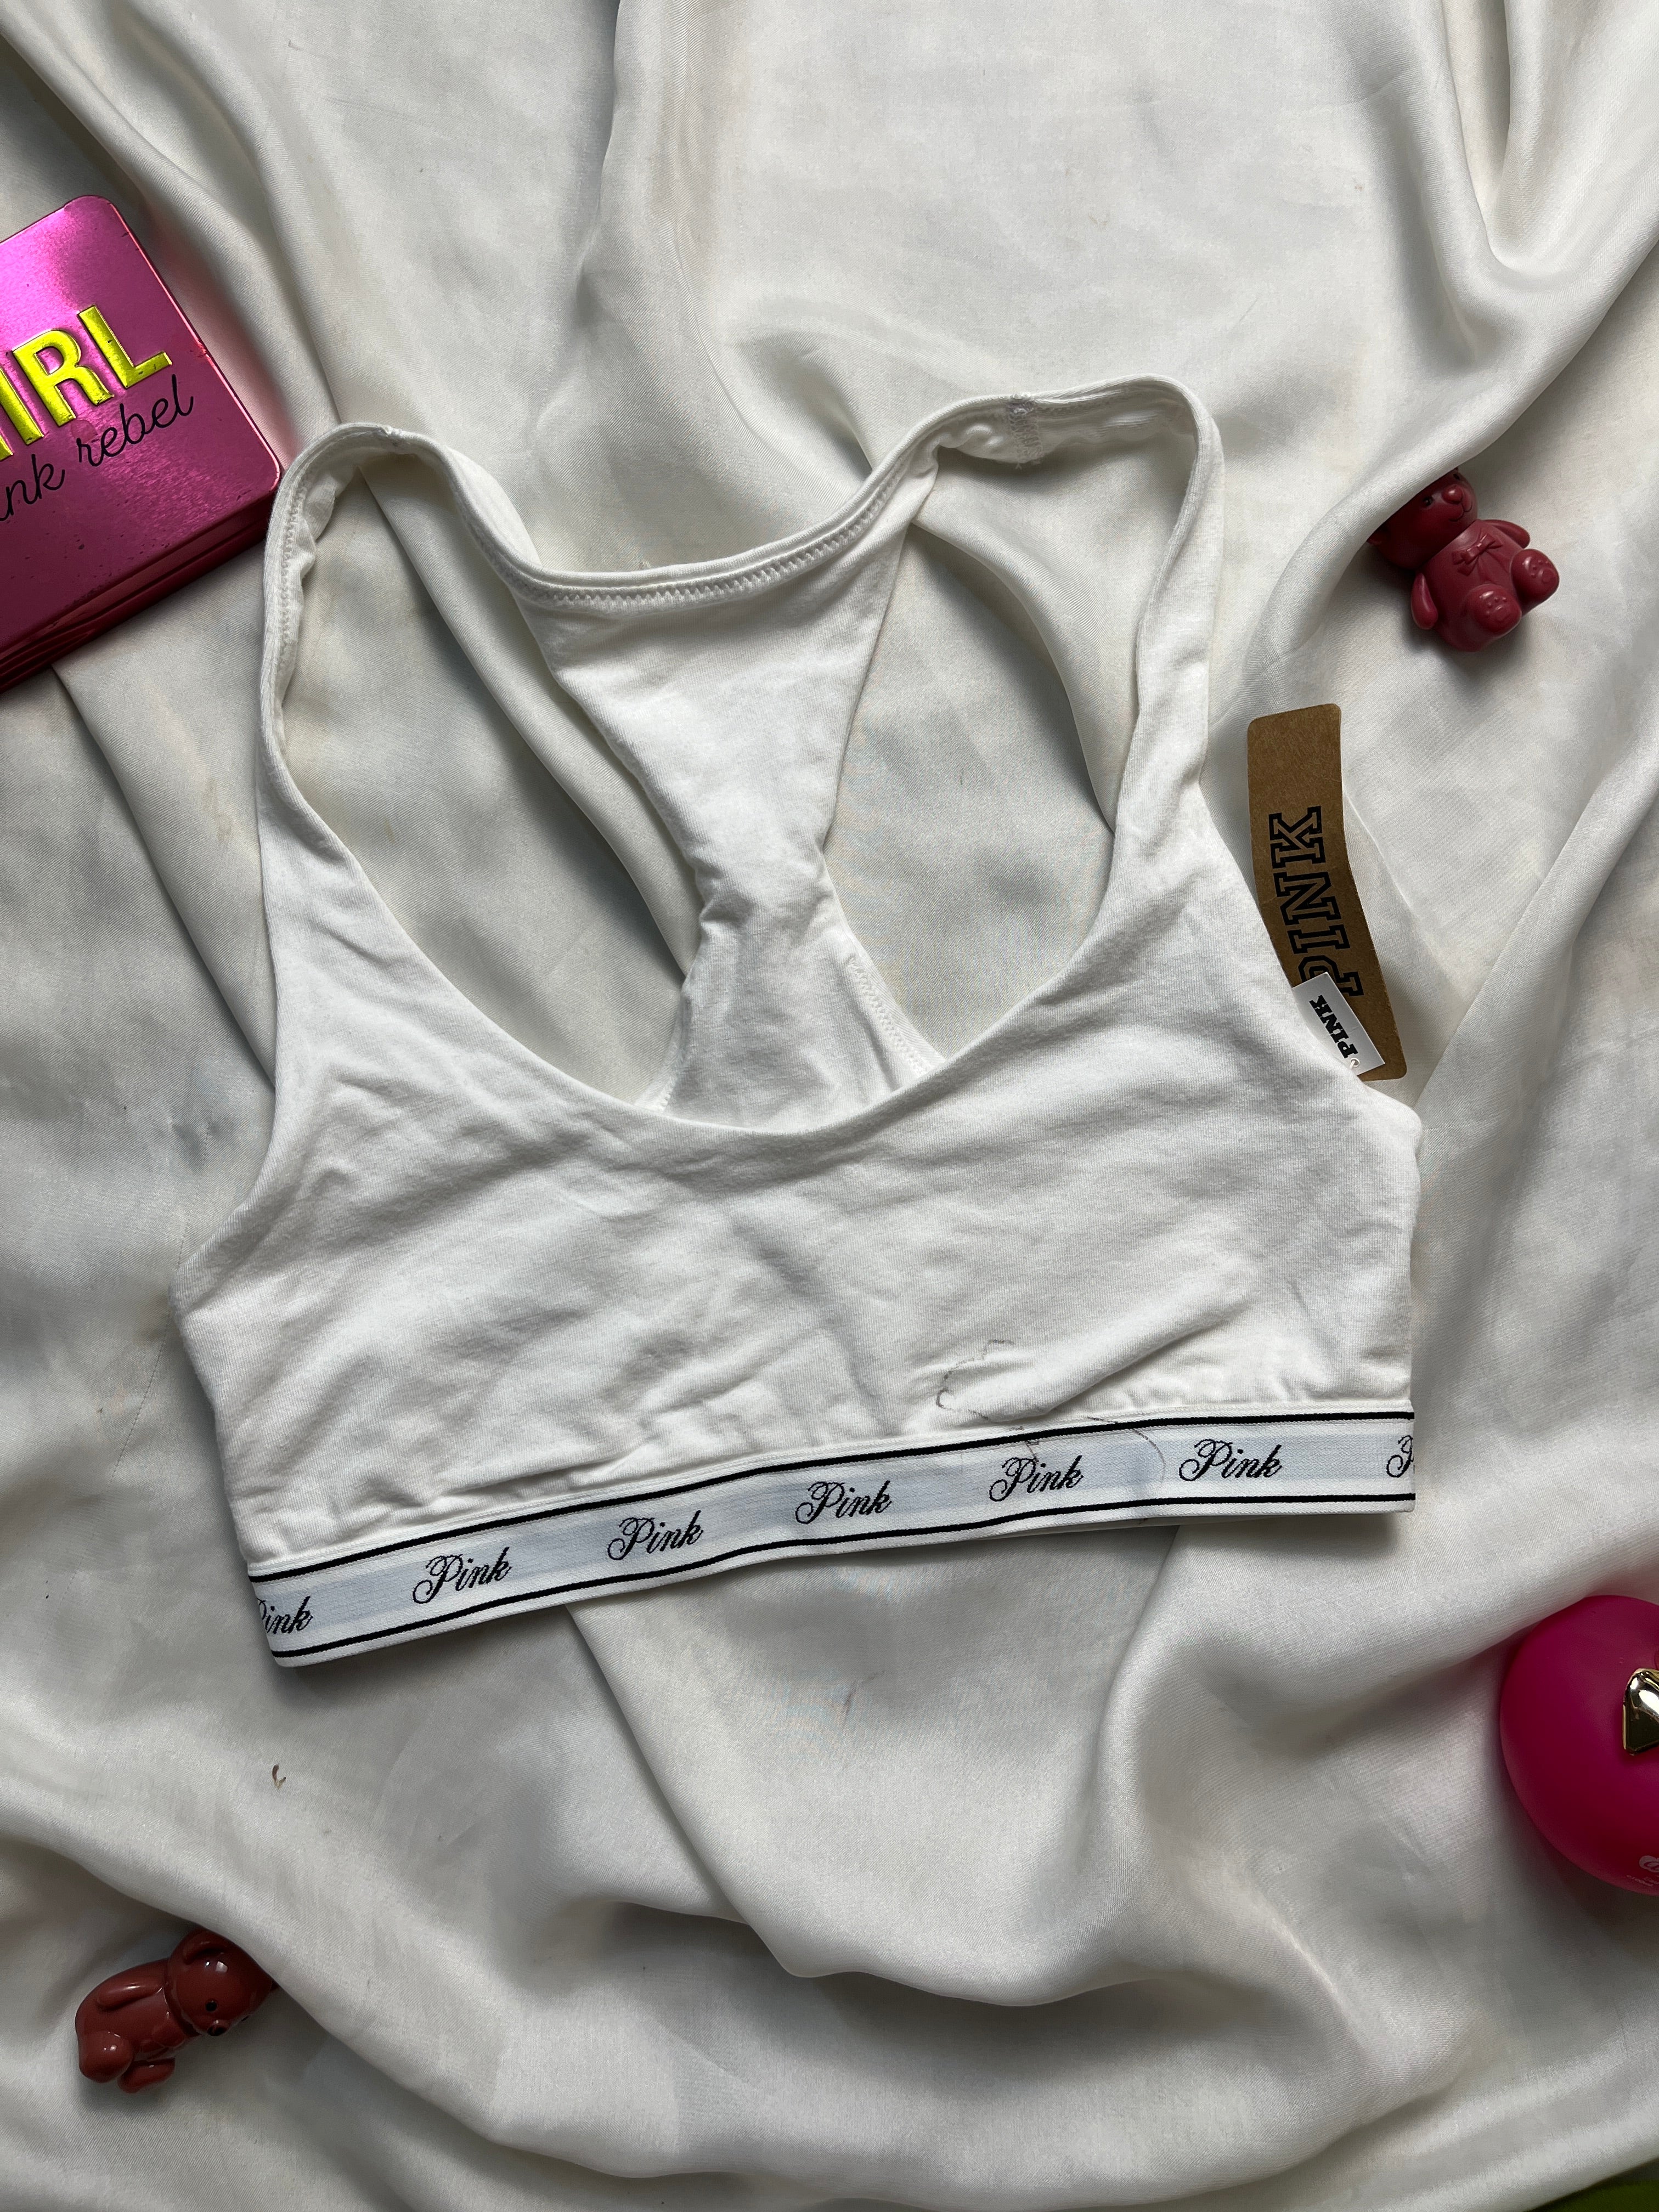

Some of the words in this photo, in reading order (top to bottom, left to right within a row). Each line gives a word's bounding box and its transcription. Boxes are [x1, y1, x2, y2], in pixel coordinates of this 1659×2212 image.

[0, 304, 173, 461] IRL
[0, 454, 65, 521] nk
[76, 374, 194, 467] rebel
[1309, 995, 1358, 1058] PINK
[412, 1547, 512, 1604] Pink
[607, 1510, 704, 1561] Pink
[795, 1480, 892, 1524] Pink
[989, 1455, 1084, 1502] Pink
[1179, 1438, 1283, 1482] Pink
